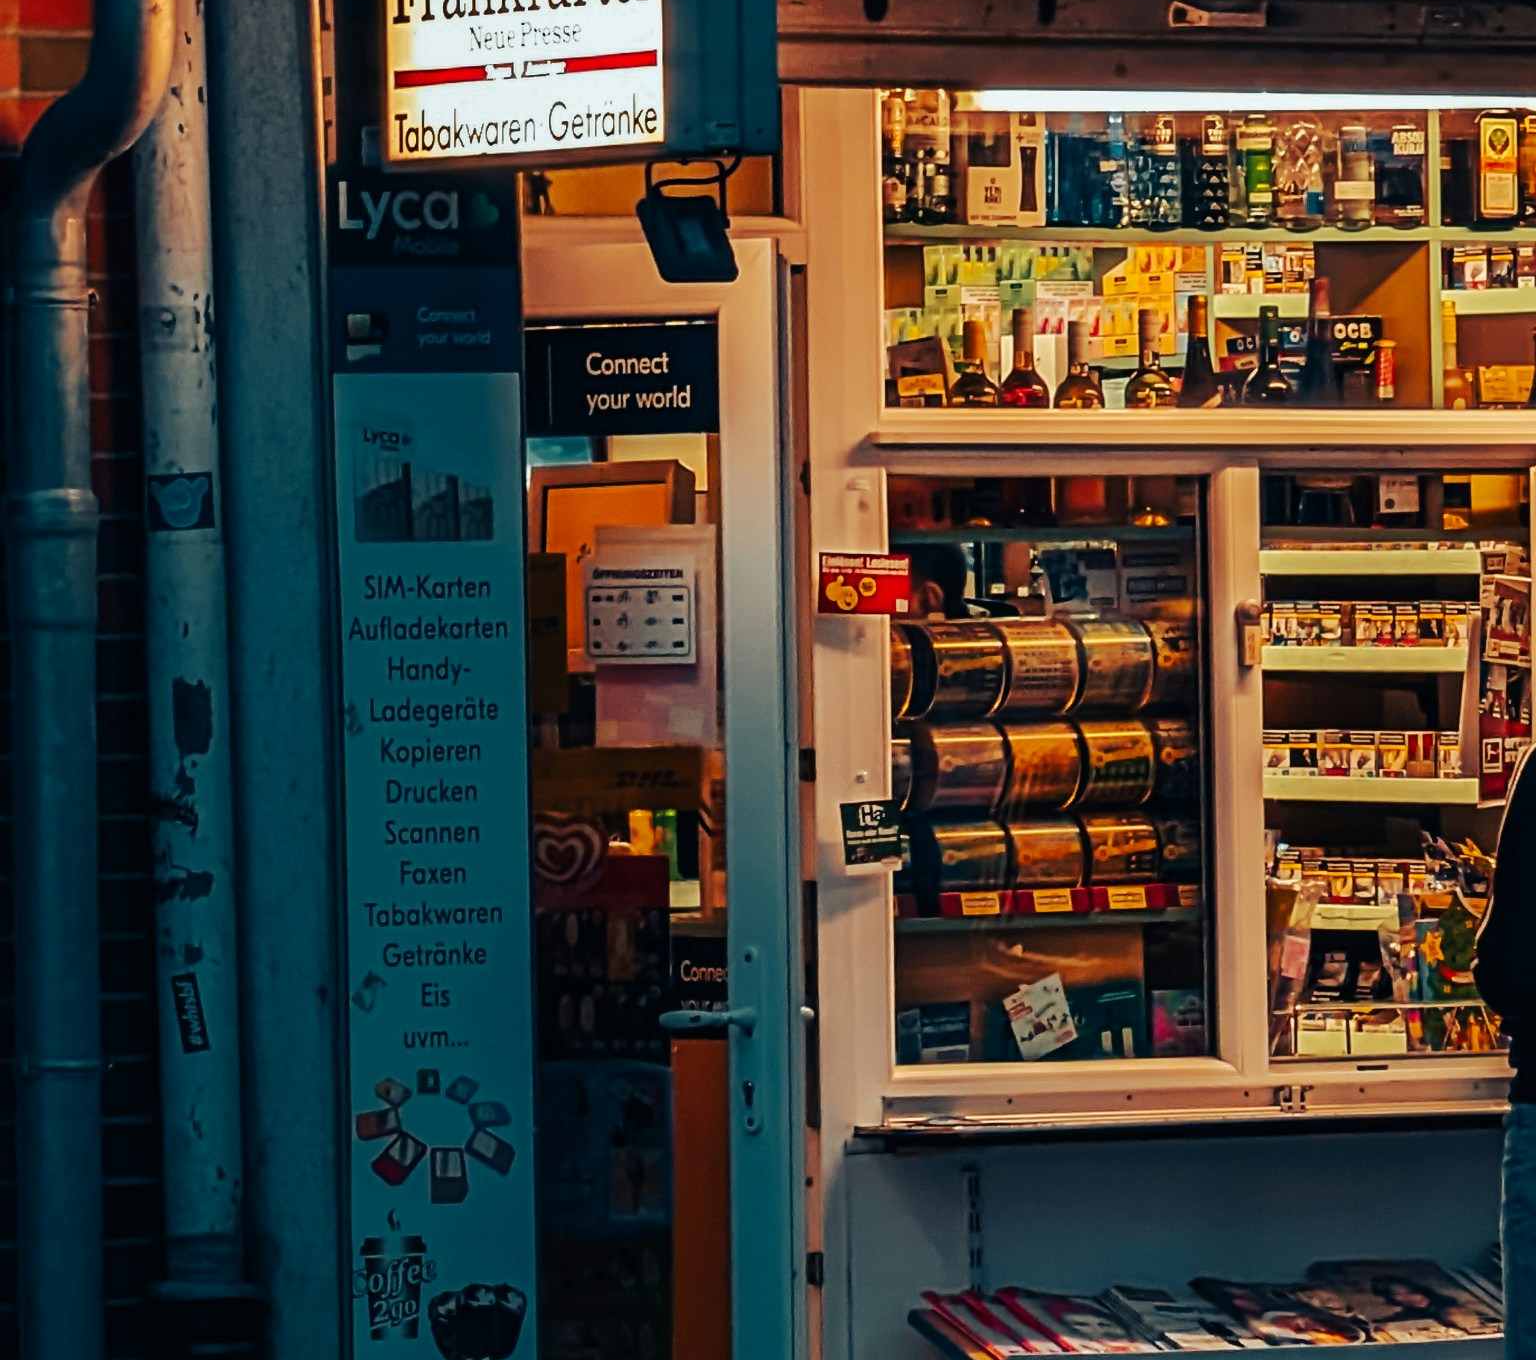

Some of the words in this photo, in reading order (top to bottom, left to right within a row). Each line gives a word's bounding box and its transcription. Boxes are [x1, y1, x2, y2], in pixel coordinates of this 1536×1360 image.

[469, 24, 516, 51] Neue
[520, 21, 582, 46] Presse
[394, 108, 537, 153] Tabakwaren
[548, 93, 657, 141] Getränke
[338, 181, 460, 240] Lyca
[1334, 323, 1372, 339] OCB
[586, 352, 669, 375] Connect
[586, 392, 630, 415] your
[636, 385, 691, 409] world
[364, 574, 491, 599] SIM-Karten
[350, 615, 508, 641] Aufladekarten
[387, 656, 472, 685] Handy-
[370, 696, 499, 728] Ladegeräte
[380, 737, 481, 767] Kopieren
[386, 780, 478, 804] Drucken
[385, 820, 480, 845] Scannen
[400, 861, 466, 885] Faxen
[364, 902, 503, 927] Tabakwaren
[383, 941, 487, 967] Getränke
[421, 983, 450, 1007] Eis
[404, 1030, 469, 1049] uvm...
[353, 1258, 438, 1299] Coffee
[373, 1300, 417, 1325] 2go
